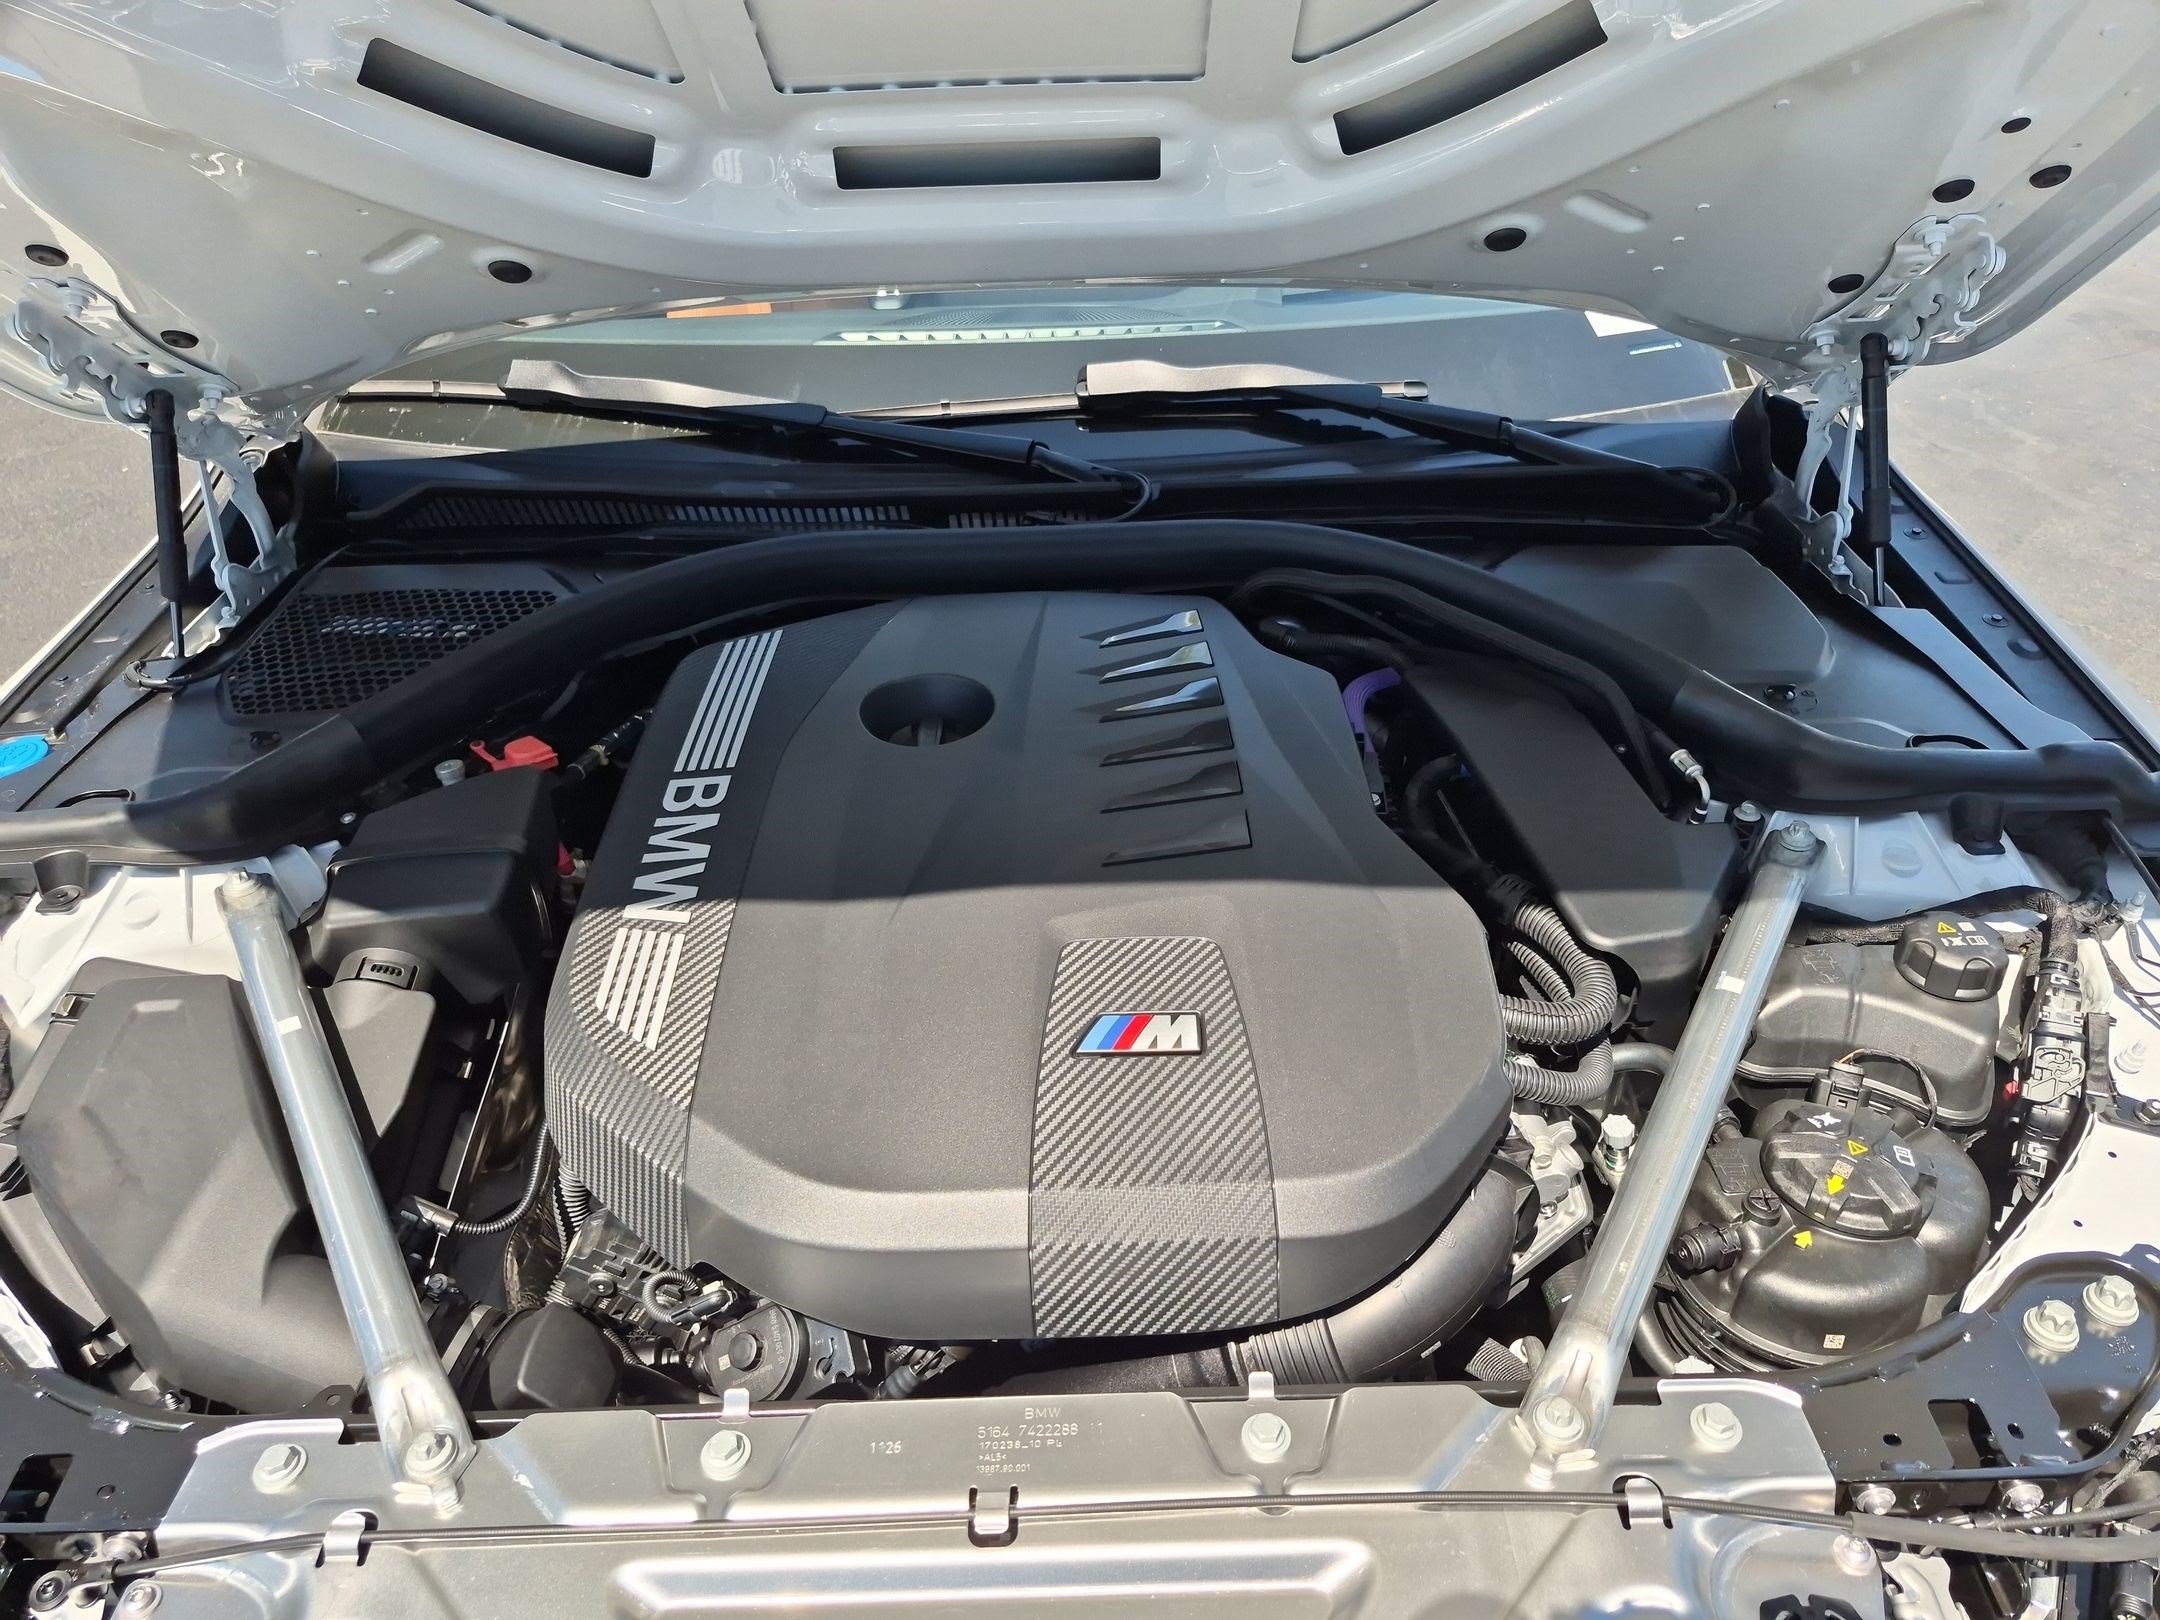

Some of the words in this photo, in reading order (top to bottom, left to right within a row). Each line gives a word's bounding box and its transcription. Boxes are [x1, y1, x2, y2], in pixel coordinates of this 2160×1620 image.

[623, 774, 732, 924] BMW
[1130, 1014, 1200, 1051] M
[1024, 1407, 1061, 1420] BMW
[977, 1425, 1010, 1439] 5164
